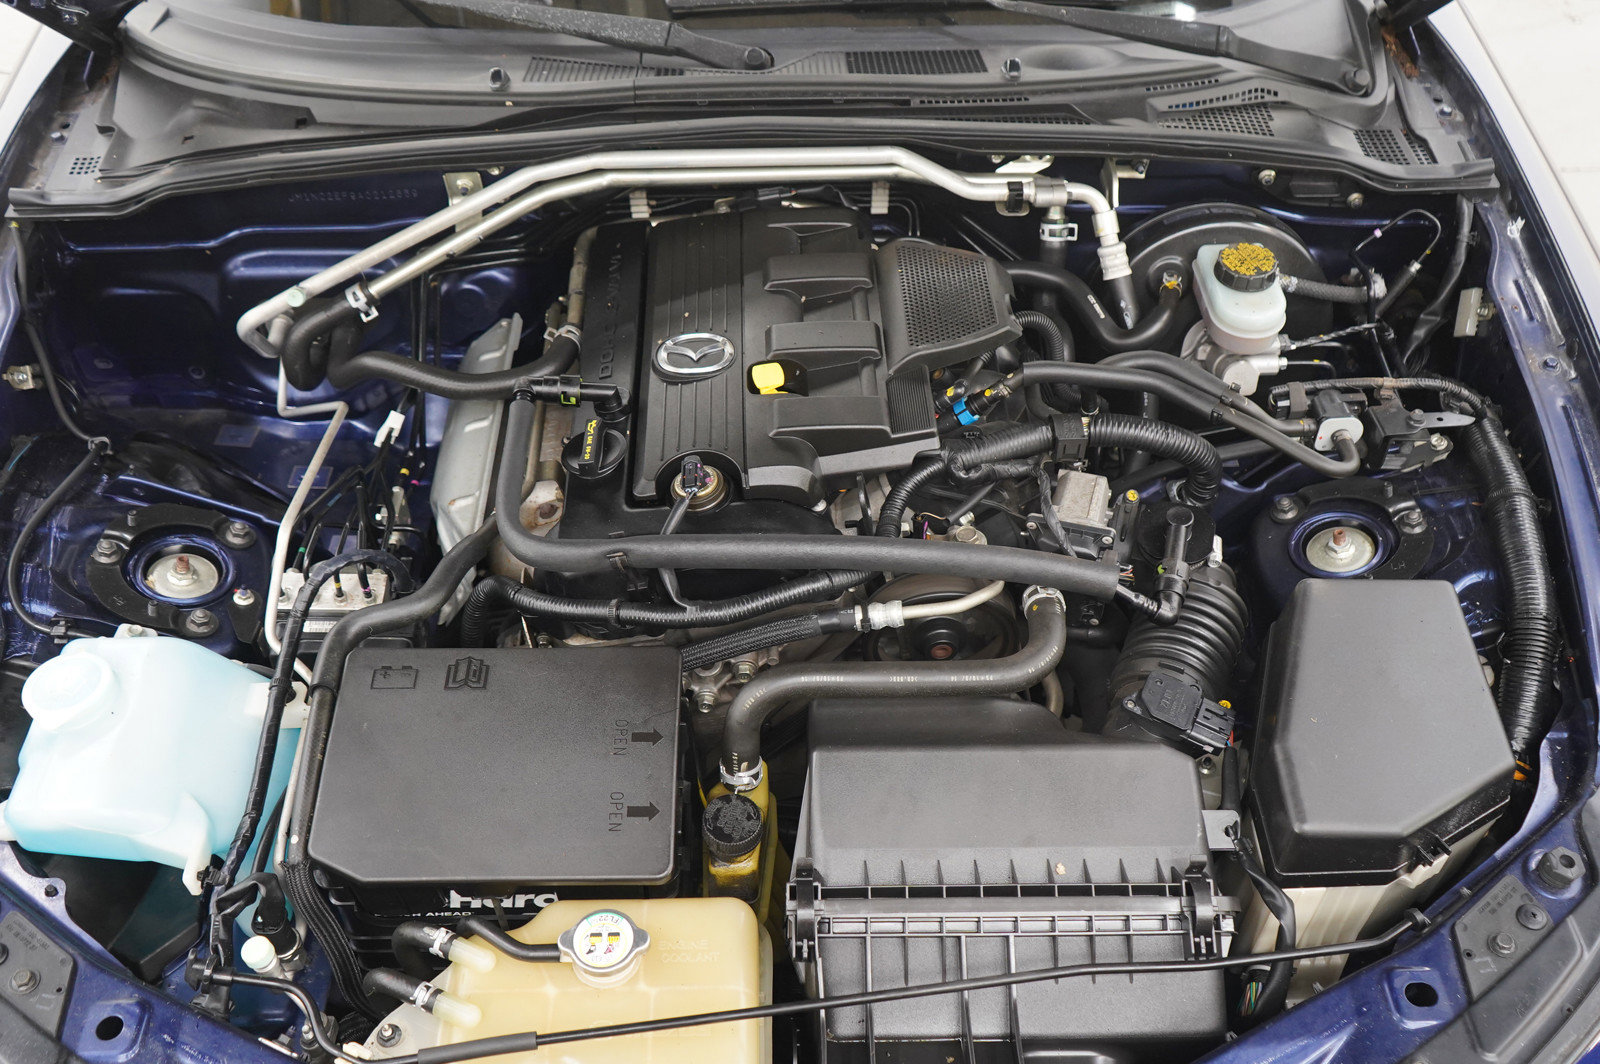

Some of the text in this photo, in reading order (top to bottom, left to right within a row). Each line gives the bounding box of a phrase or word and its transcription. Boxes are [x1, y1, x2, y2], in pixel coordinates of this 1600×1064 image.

[613, 720, 629, 755] OPEN
[608, 792, 624, 831] OPEN
[598, 915, 620, 924] FL22
[661, 952, 720, 964] COOLANT
